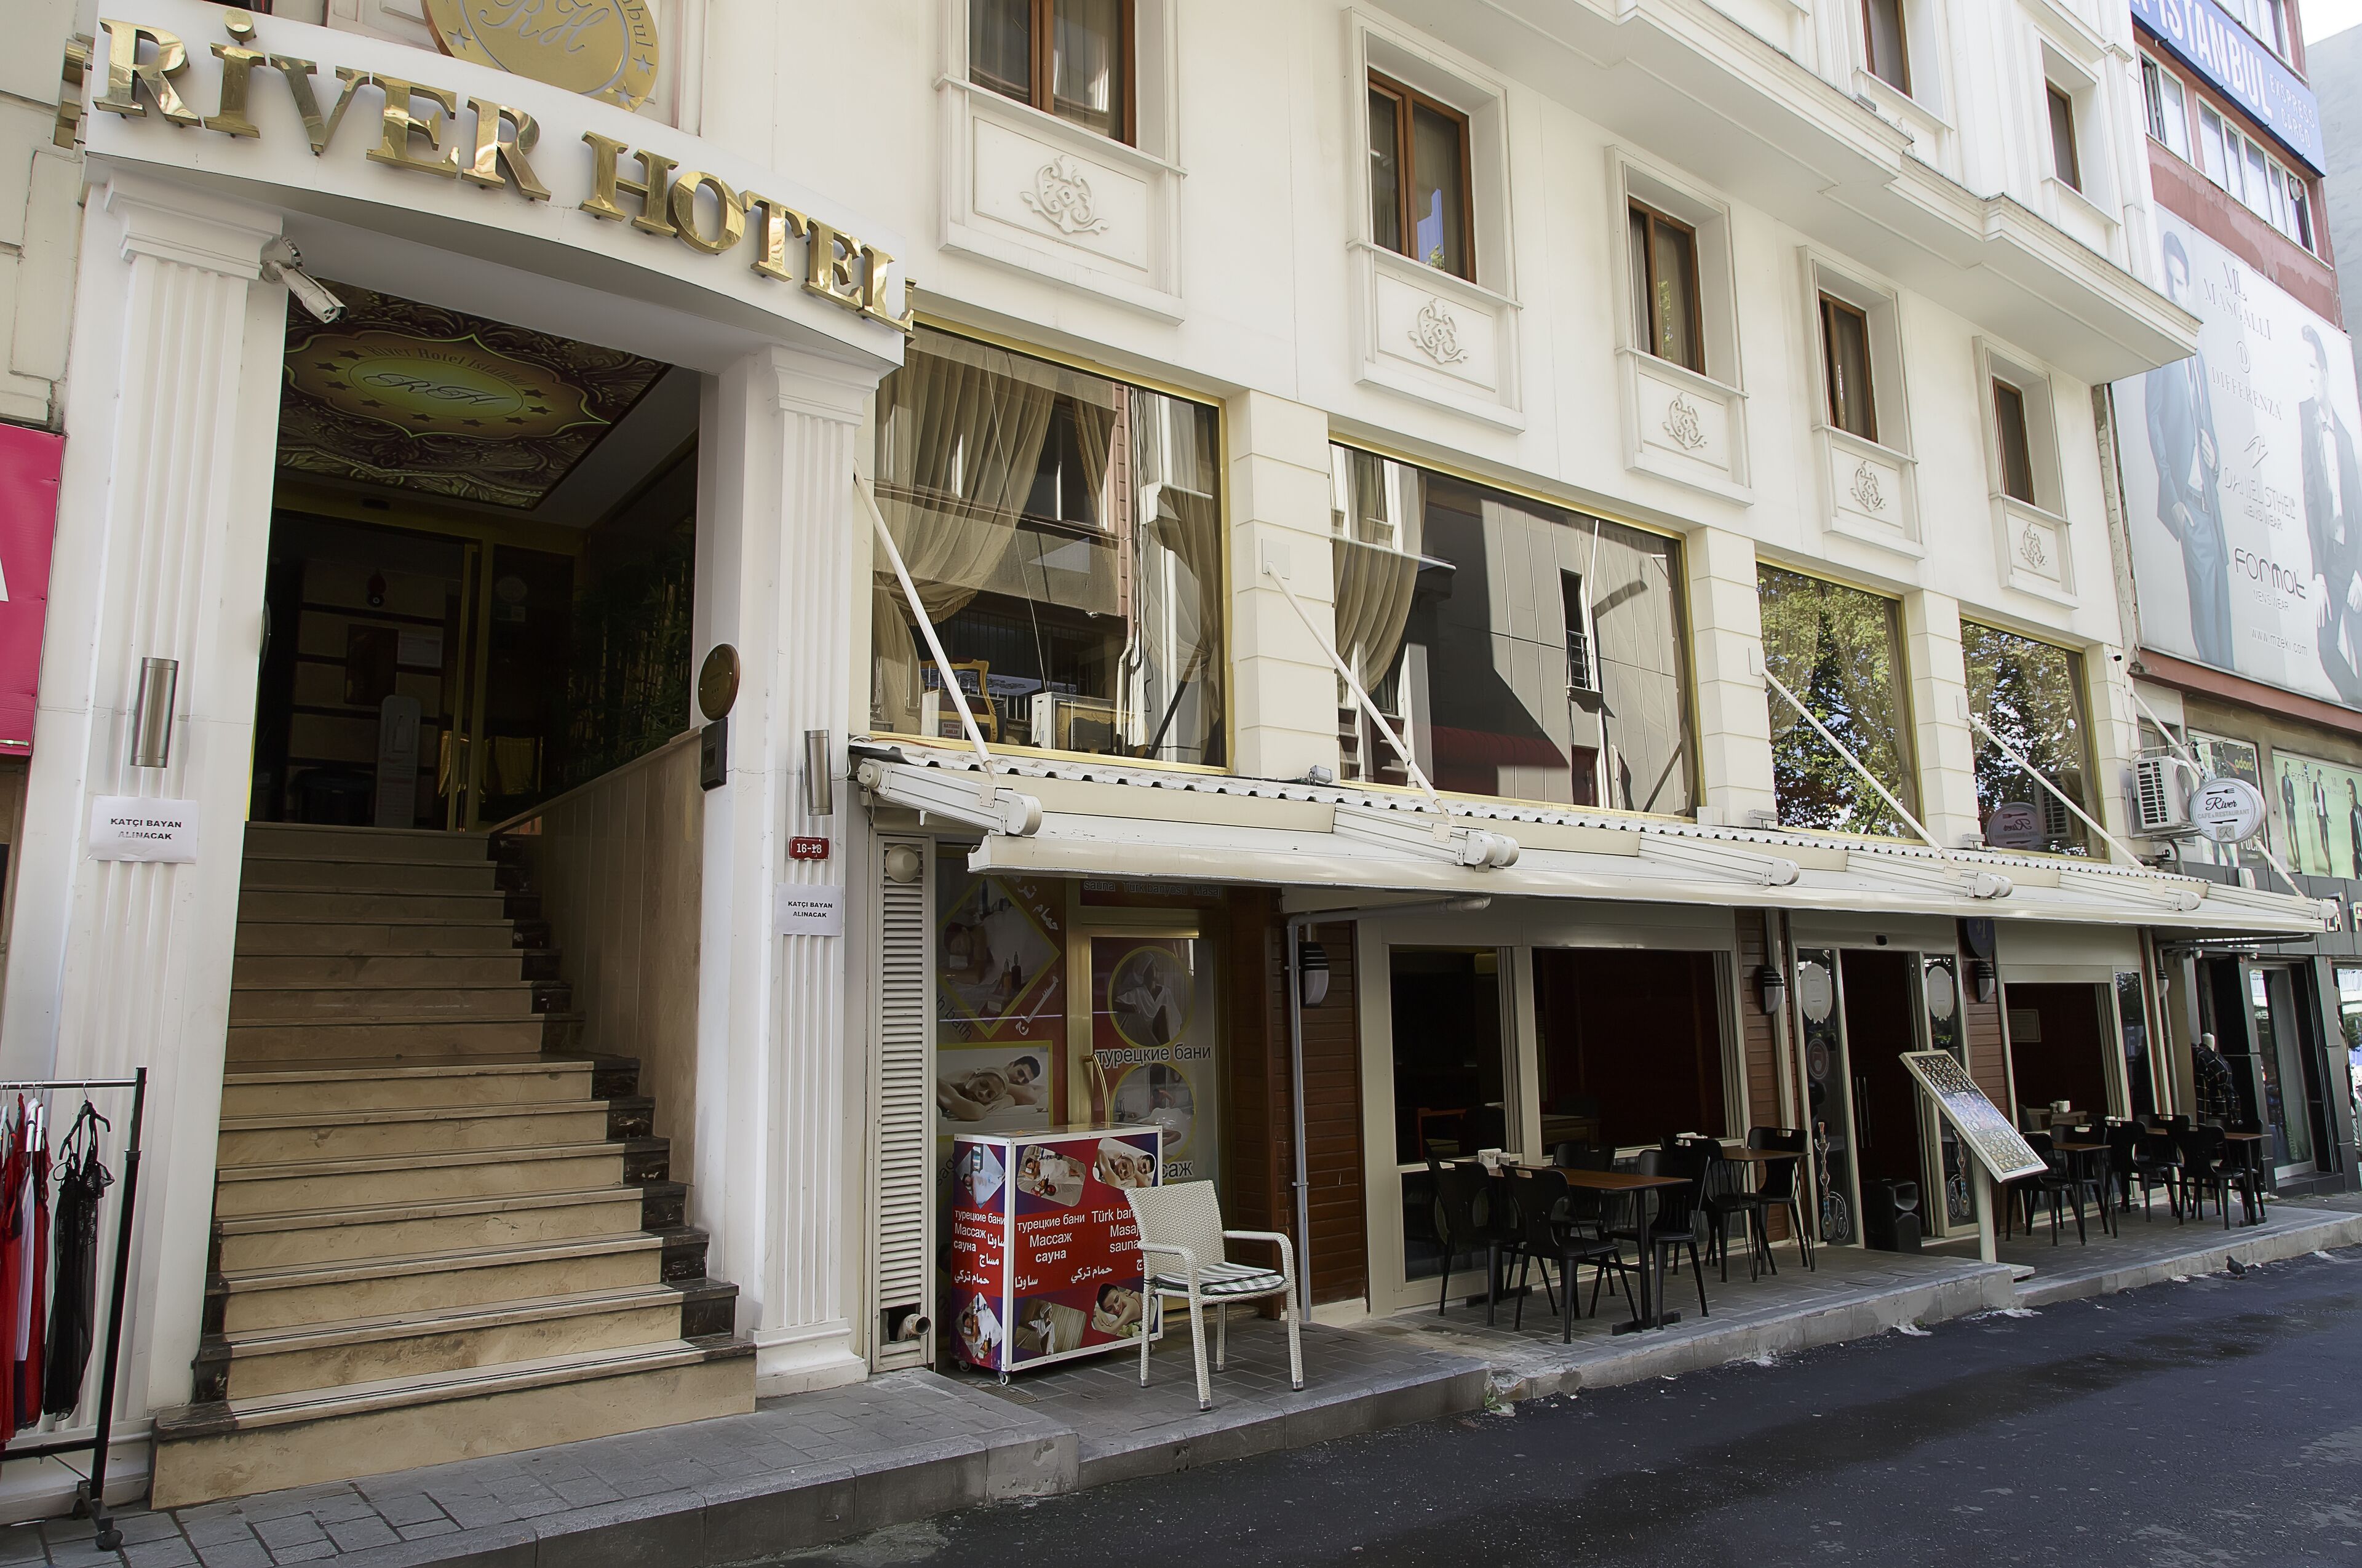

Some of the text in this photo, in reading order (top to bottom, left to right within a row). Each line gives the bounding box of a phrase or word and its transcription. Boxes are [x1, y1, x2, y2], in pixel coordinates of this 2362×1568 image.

[2269, 73, 2315, 129] EXSPRESS
[2281, 108, 2311, 148] CARGO
[578, 130, 914, 333] HOTEL
[2203, 277, 2272, 340] MASGALLI
[362, 345, 412, 357] River
[418, 348, 466, 365] Hotel
[2211, 367, 2282, 421] DIFFERENZA
[2251, 627, 2308, 657] www.mzeki.com
[2205, 797, 2237, 811] River
[2215, 809, 2249, 818] RESTAURANT
[110, 818, 143, 827] KATÇI
[118, 831, 173, 840] ALINACAK
[797, 843, 822, 854] 16-18
[1083, 880, 1116, 892] sauna
[1147, 882, 1188, 897] banyosu
[1193, 885, 1222, 899] Masaj
[944, 1006, 973, 1040] bath
[1096, 1043, 1211, 1068] турецкие бани
[955, 1210, 987, 1222] турецкие
[1017, 1213, 1086, 1233] турецкие бани
[1091, 1208, 1114, 1224] Türk
[955, 1222, 987, 1239] Массаж
[1110, 1224, 1140, 1238] Masaj
[953, 1240, 977, 1252] сауна
[1030, 1232, 1072, 1248] Массаж
[1110, 1240, 1139, 1253] sauna
[979, 1252, 1000, 1268] مساج
[1035, 1249, 1067, 1264] сауна
[972, 1272, 990, 1285] حمام
[1014, 1274, 1038, 1290] ساونا
[1070, 1265, 1113, 1283] حمام تركي
